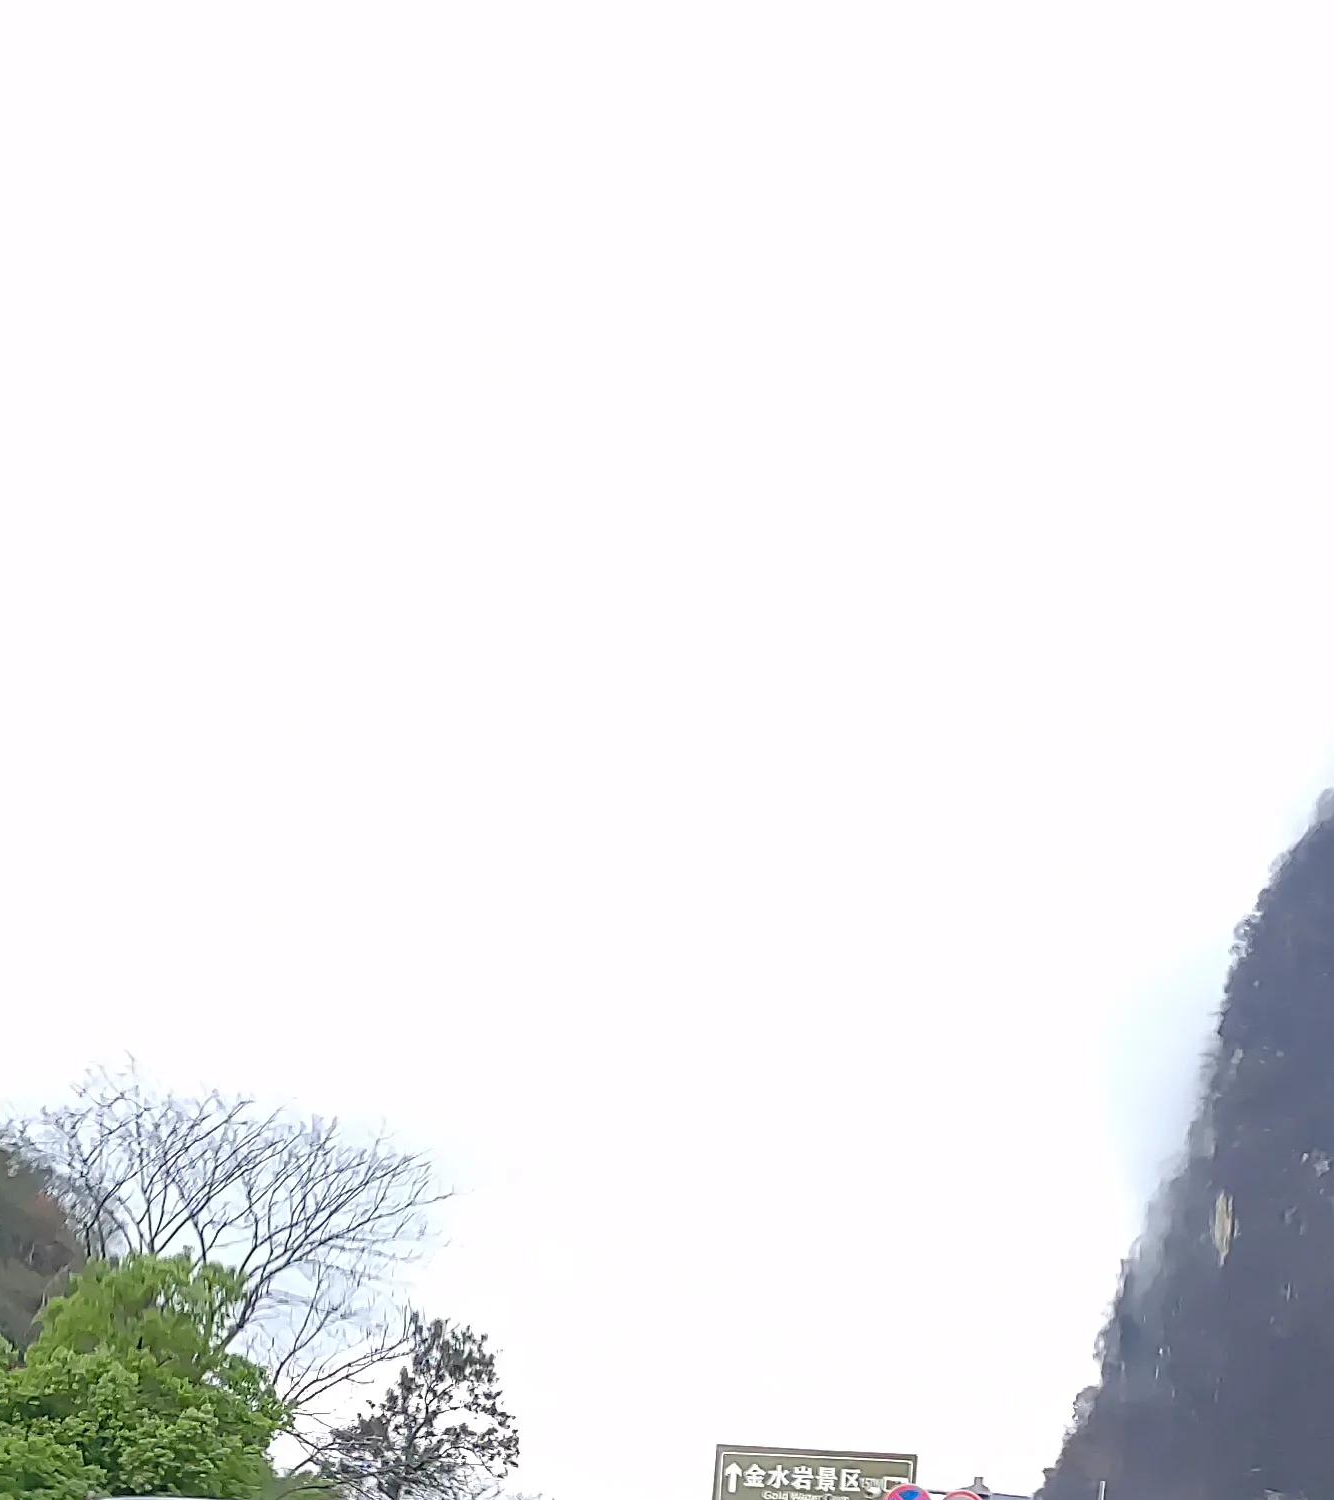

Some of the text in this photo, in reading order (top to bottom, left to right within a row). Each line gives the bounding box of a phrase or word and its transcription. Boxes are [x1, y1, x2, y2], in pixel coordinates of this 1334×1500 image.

[743, 1463, 862, 1492] 金水岩景区
